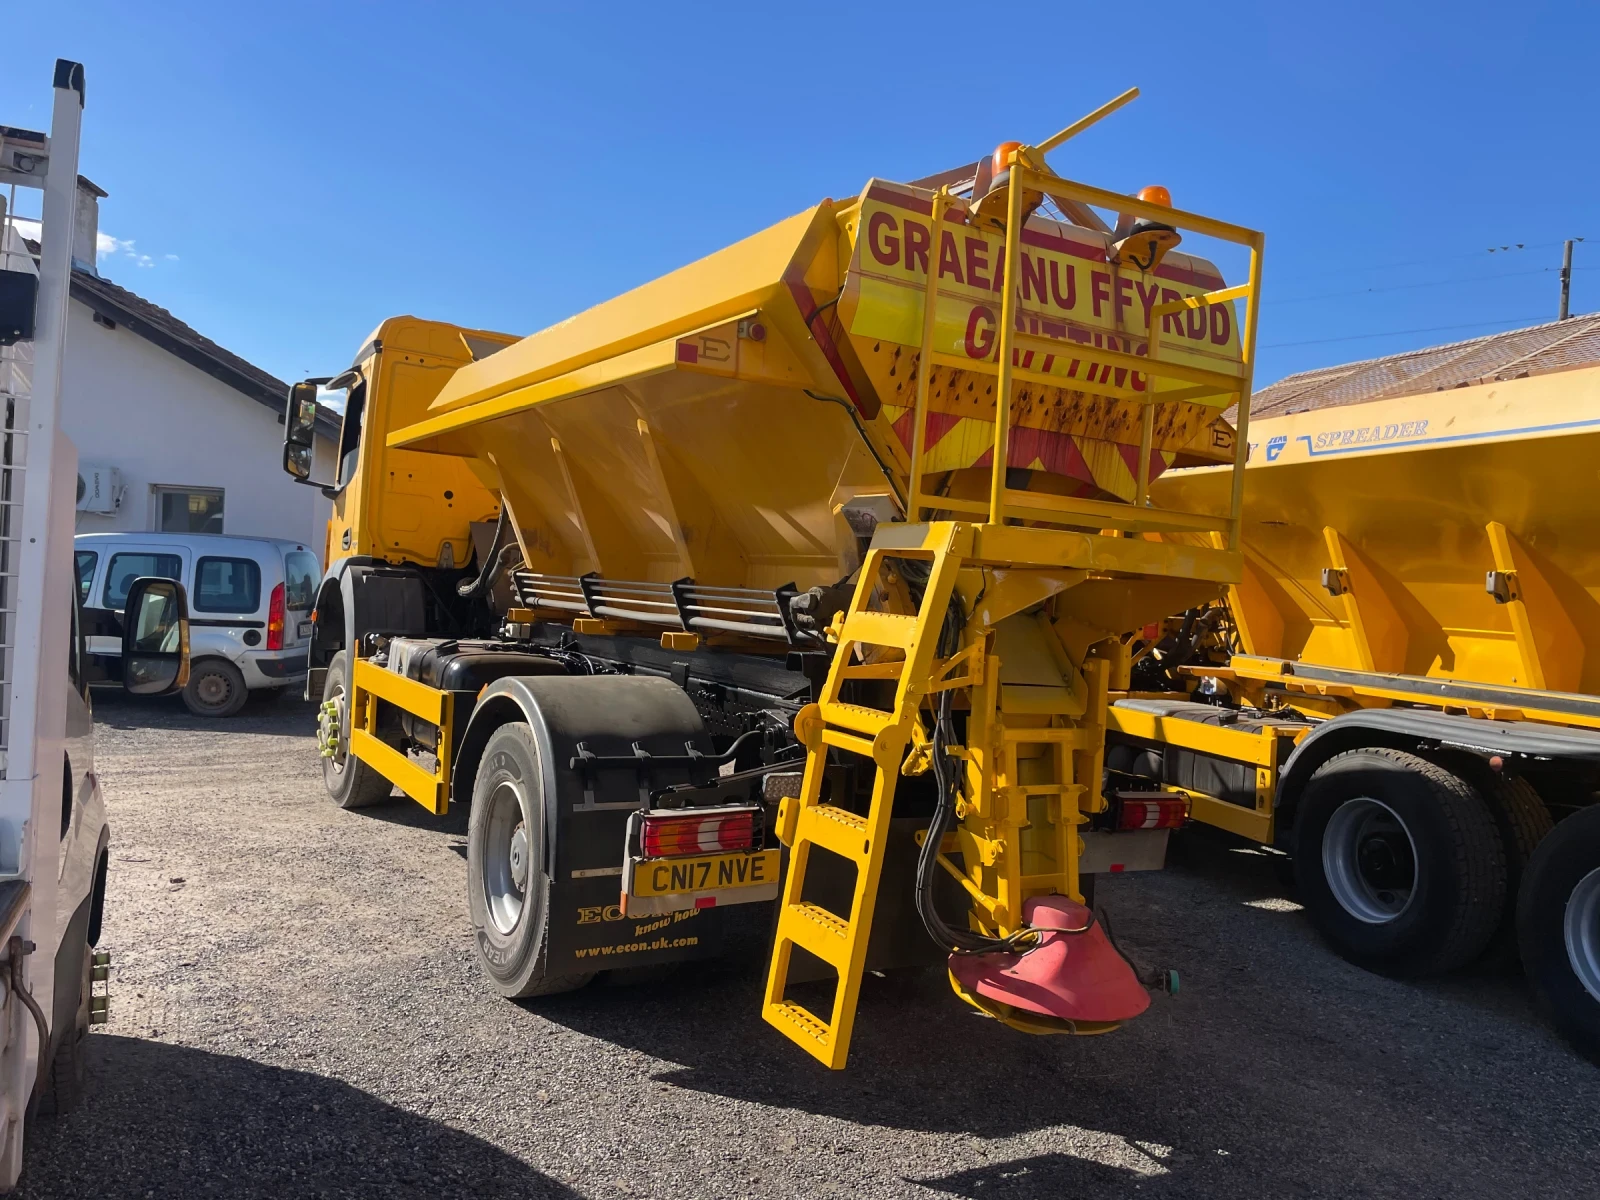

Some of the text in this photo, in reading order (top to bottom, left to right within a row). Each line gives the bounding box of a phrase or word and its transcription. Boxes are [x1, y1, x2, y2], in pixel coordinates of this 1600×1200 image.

[1090, 270, 1231, 346] FFYRDD
[1314, 419, 1429, 449] SPREADER
[652, 855, 766, 892] CN17 NVE
[576, 904, 673, 925] EC
[634, 906, 701, 937] know how
[575, 935, 699, 959] www.econ.uk.com
